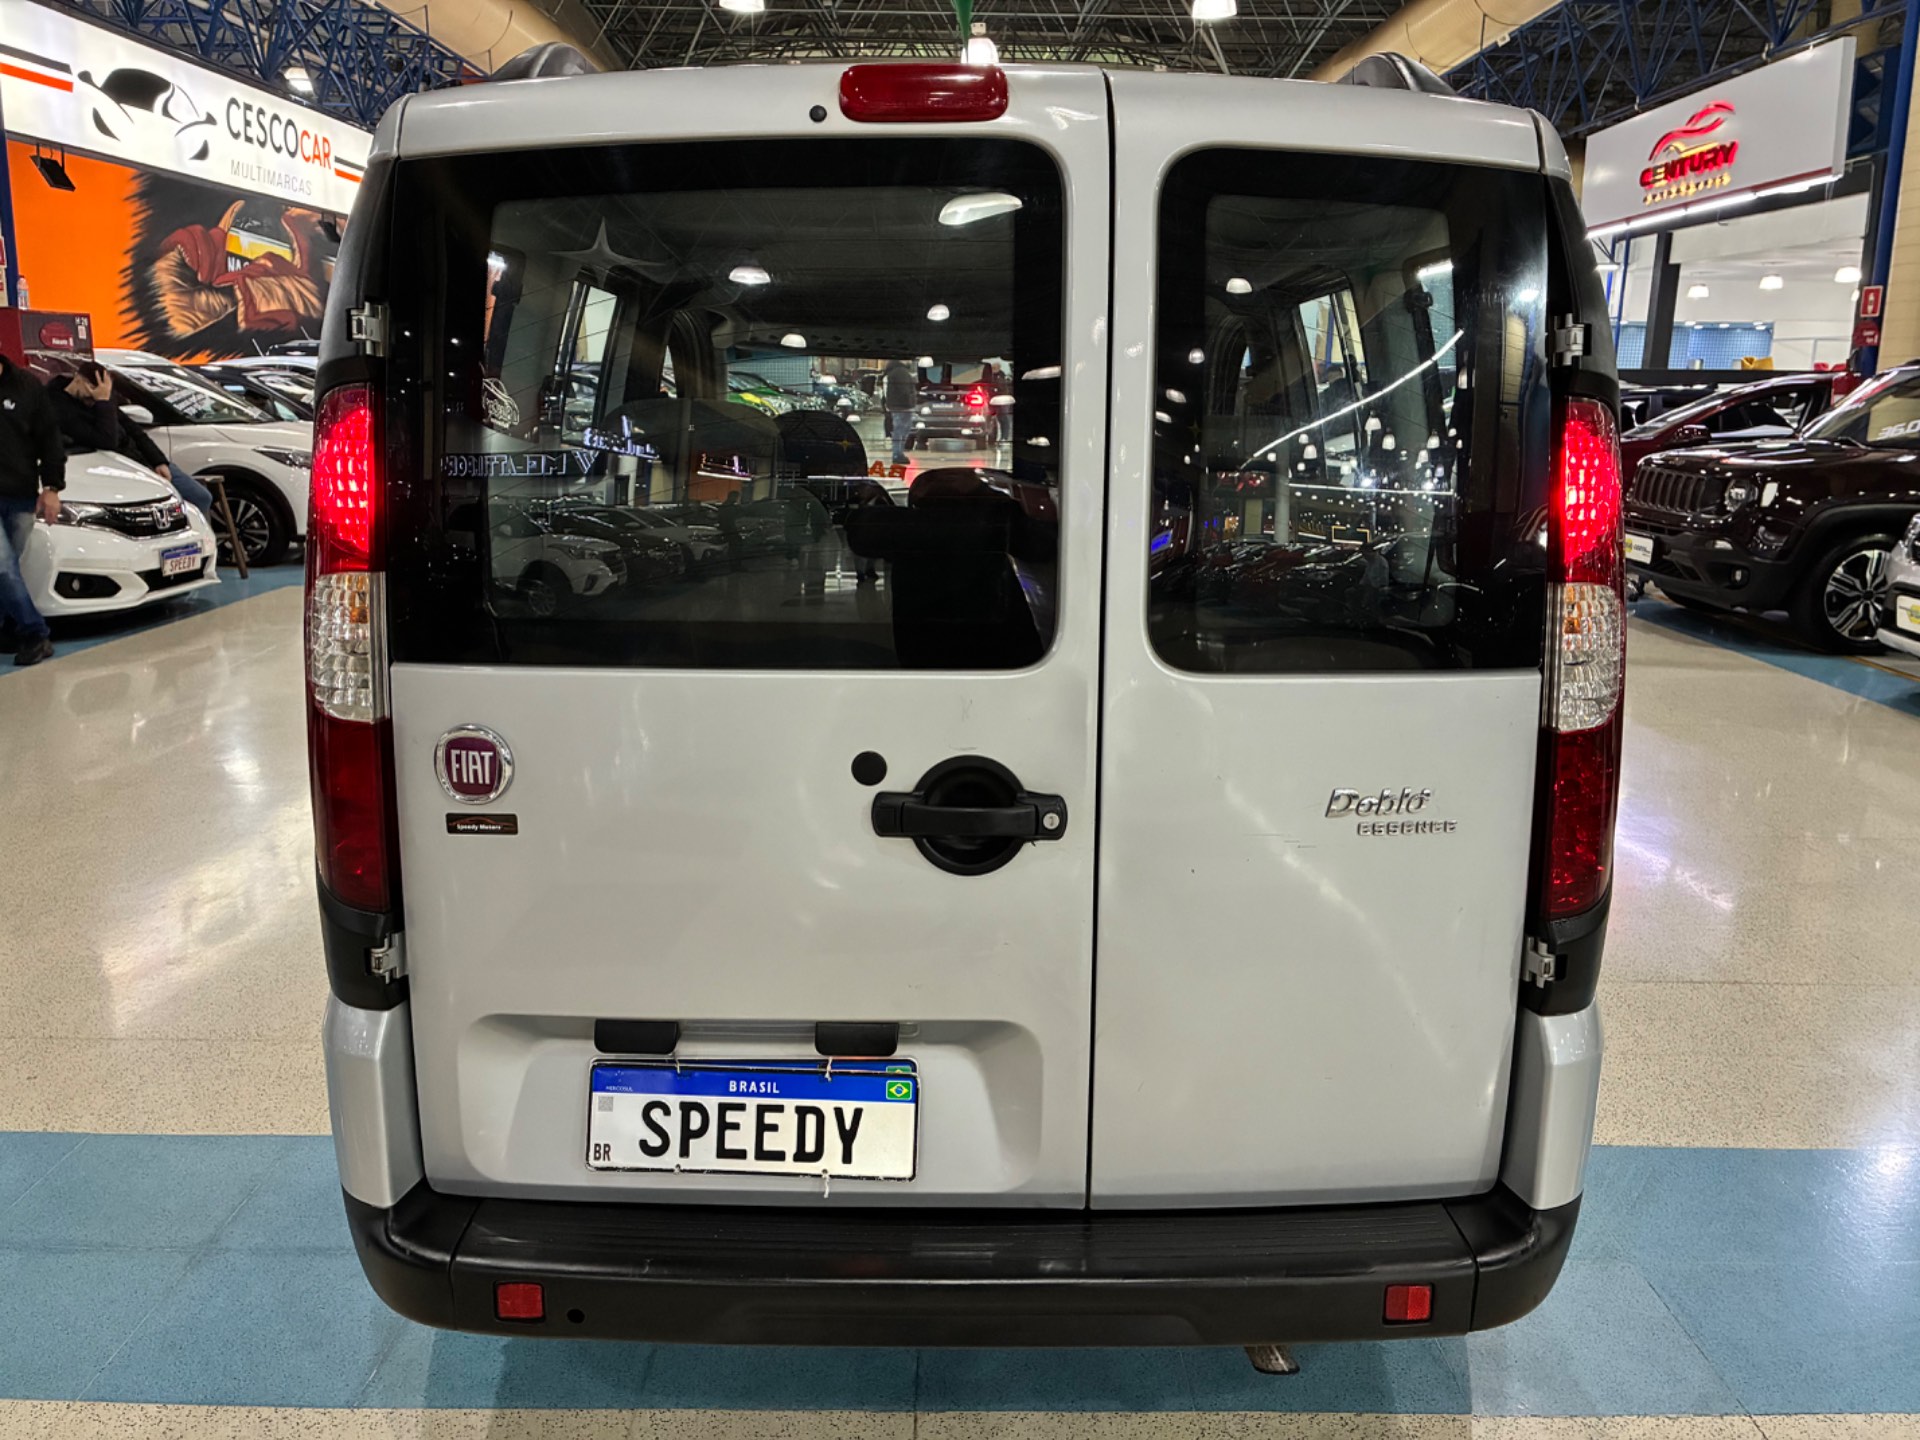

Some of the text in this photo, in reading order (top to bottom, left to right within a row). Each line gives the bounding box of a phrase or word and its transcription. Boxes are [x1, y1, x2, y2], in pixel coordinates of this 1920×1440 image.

[226, 96, 332, 170] CESCOCAR
[230, 159, 312, 196] MULTIMARCAS
[1639, 139, 1739, 189] CENTURY
[171, 557, 196, 571] SPEEDY
[450, 748, 494, 785] FIAT
[456, 823, 502, 832] Speedy Motors
[1357, 820, 1457, 836] ESSENCE
[728, 1079, 780, 1095] BRASIL
[638, 1100, 864, 1165] SPEEDY
[593, 1143, 611, 1162] BR
